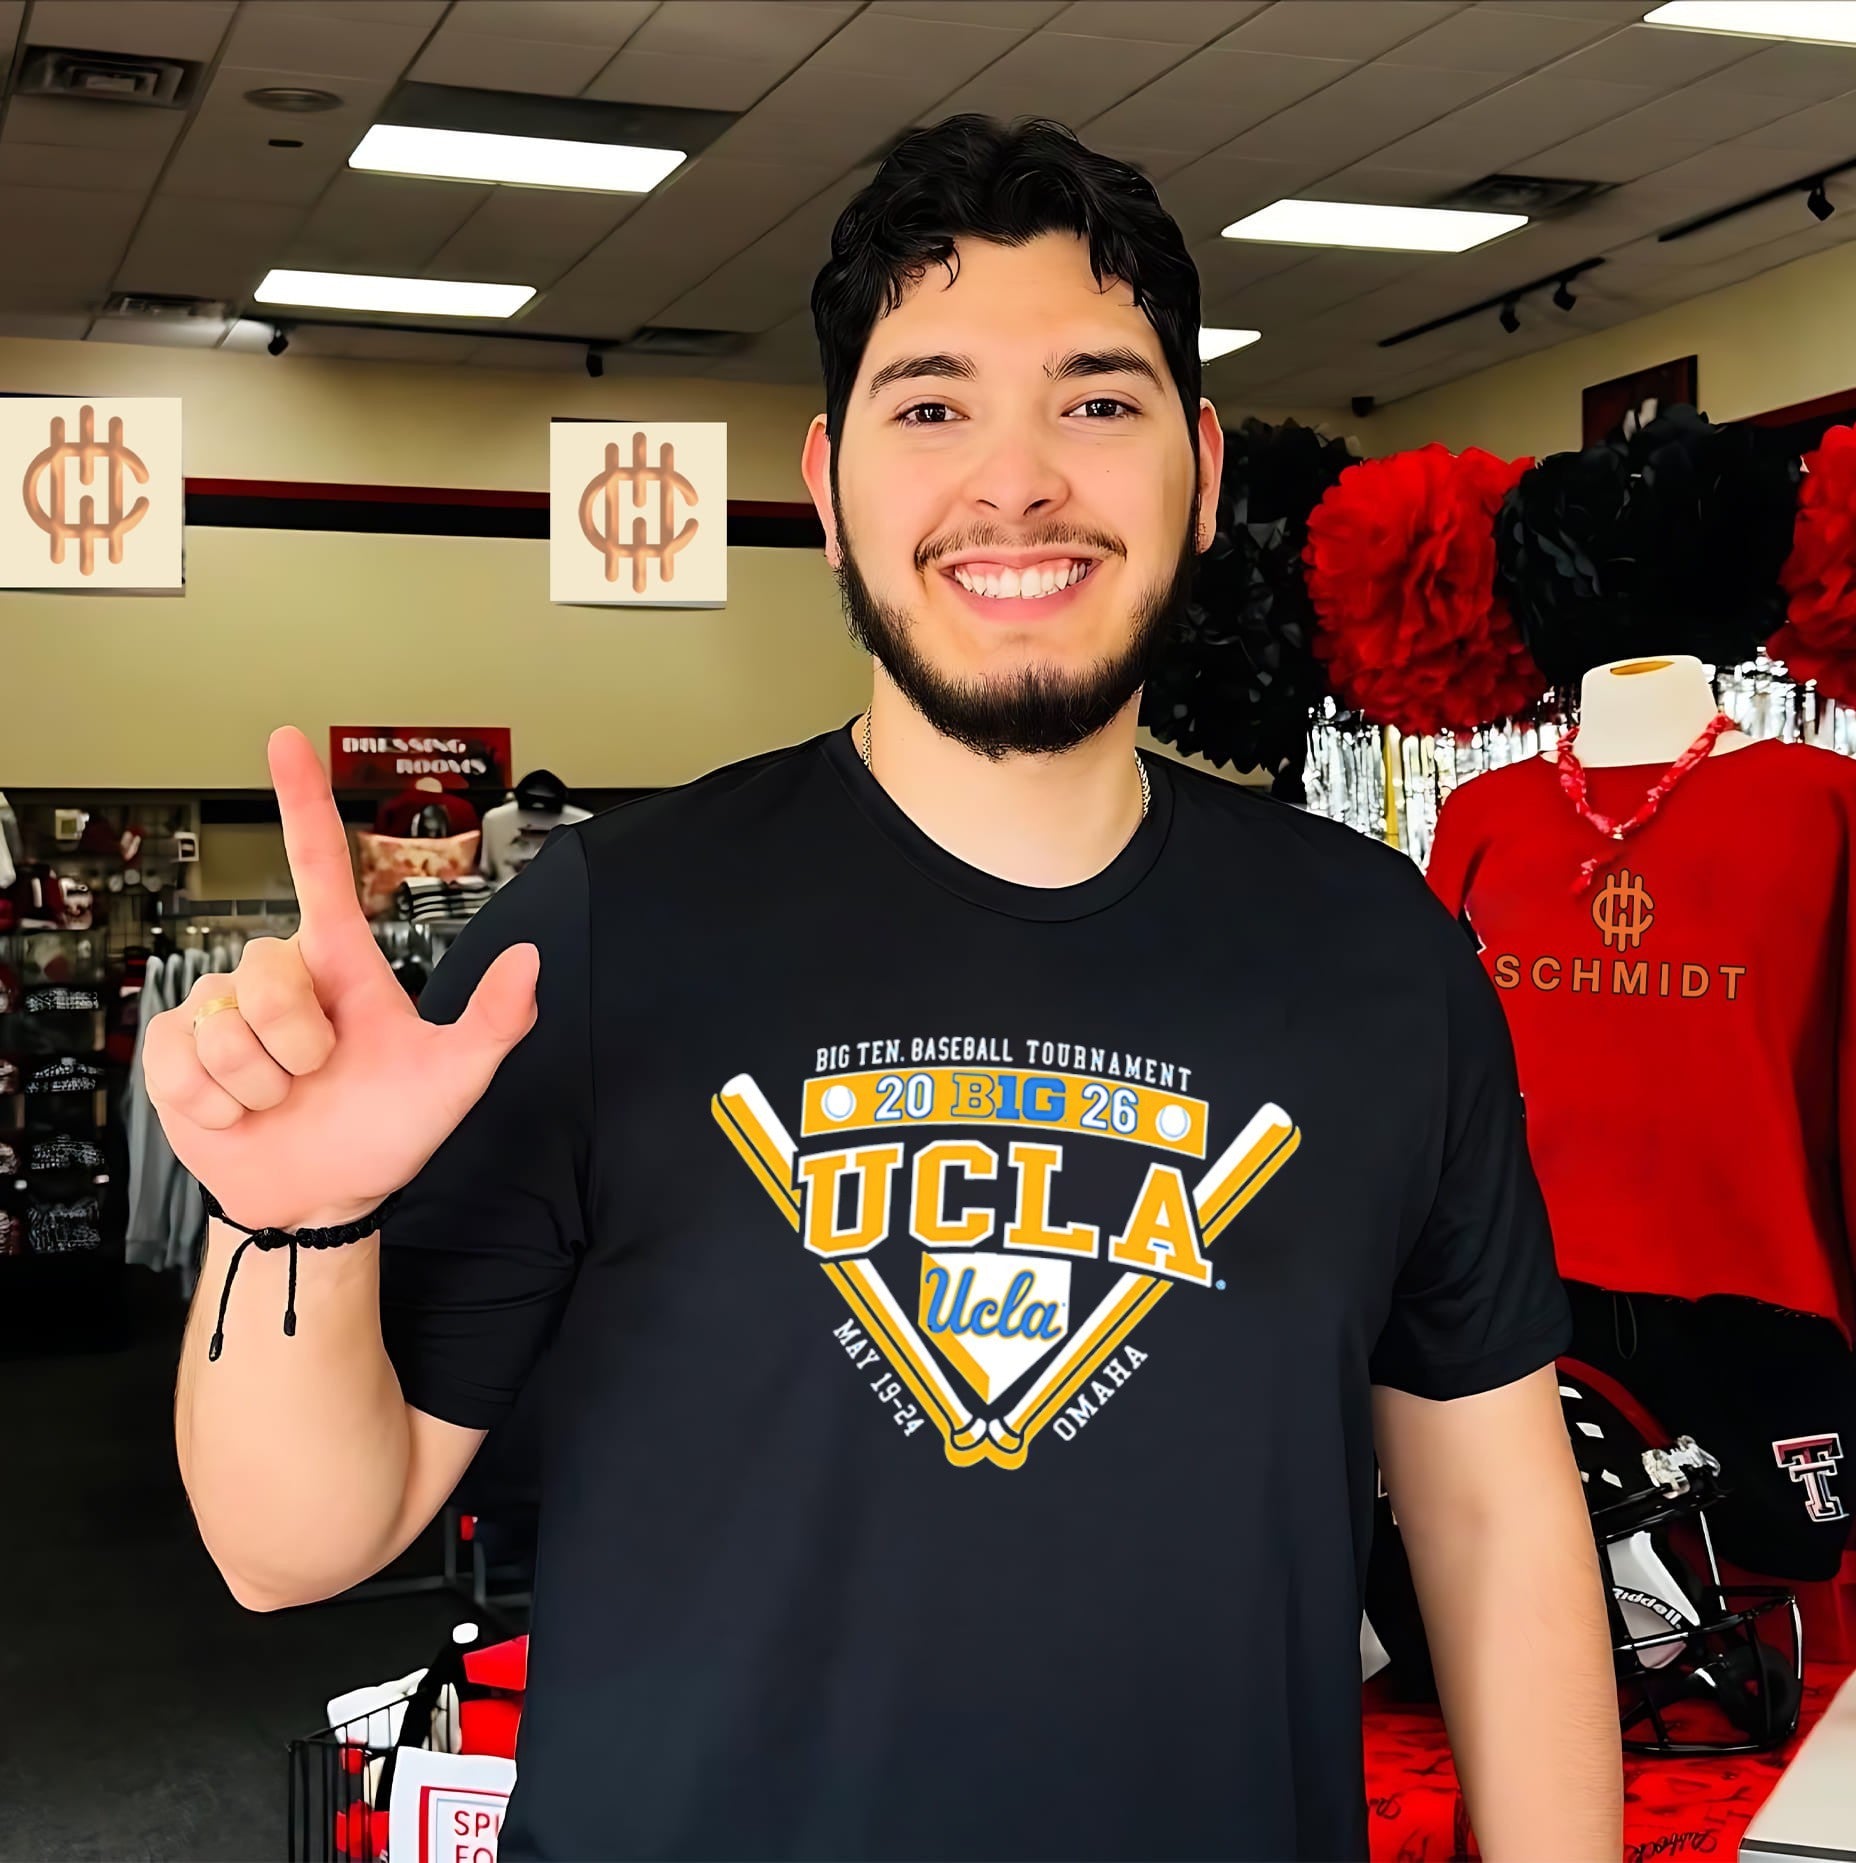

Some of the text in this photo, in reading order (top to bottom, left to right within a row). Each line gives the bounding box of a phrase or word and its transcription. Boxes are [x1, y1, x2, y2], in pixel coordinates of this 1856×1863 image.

[342, 737, 466, 753] DRESSING
[396, 758, 487, 774] ROOMS
[1494, 954, 1747, 1000] SCHMIDT
[815, 1045, 850, 1072] BIG
[911, 1037, 1013, 1063] BASEBALL
[1026, 1039, 1191, 1092] TOURNAMENT
[874, 1073, 935, 1121] 20
[1080, 1083, 1139, 1134] 26
[798, 1139, 1213, 1288] UCLA
[832, 1318, 926, 1438] MAY 19-24
[1052, 1344, 1150, 1442] OMAHA
